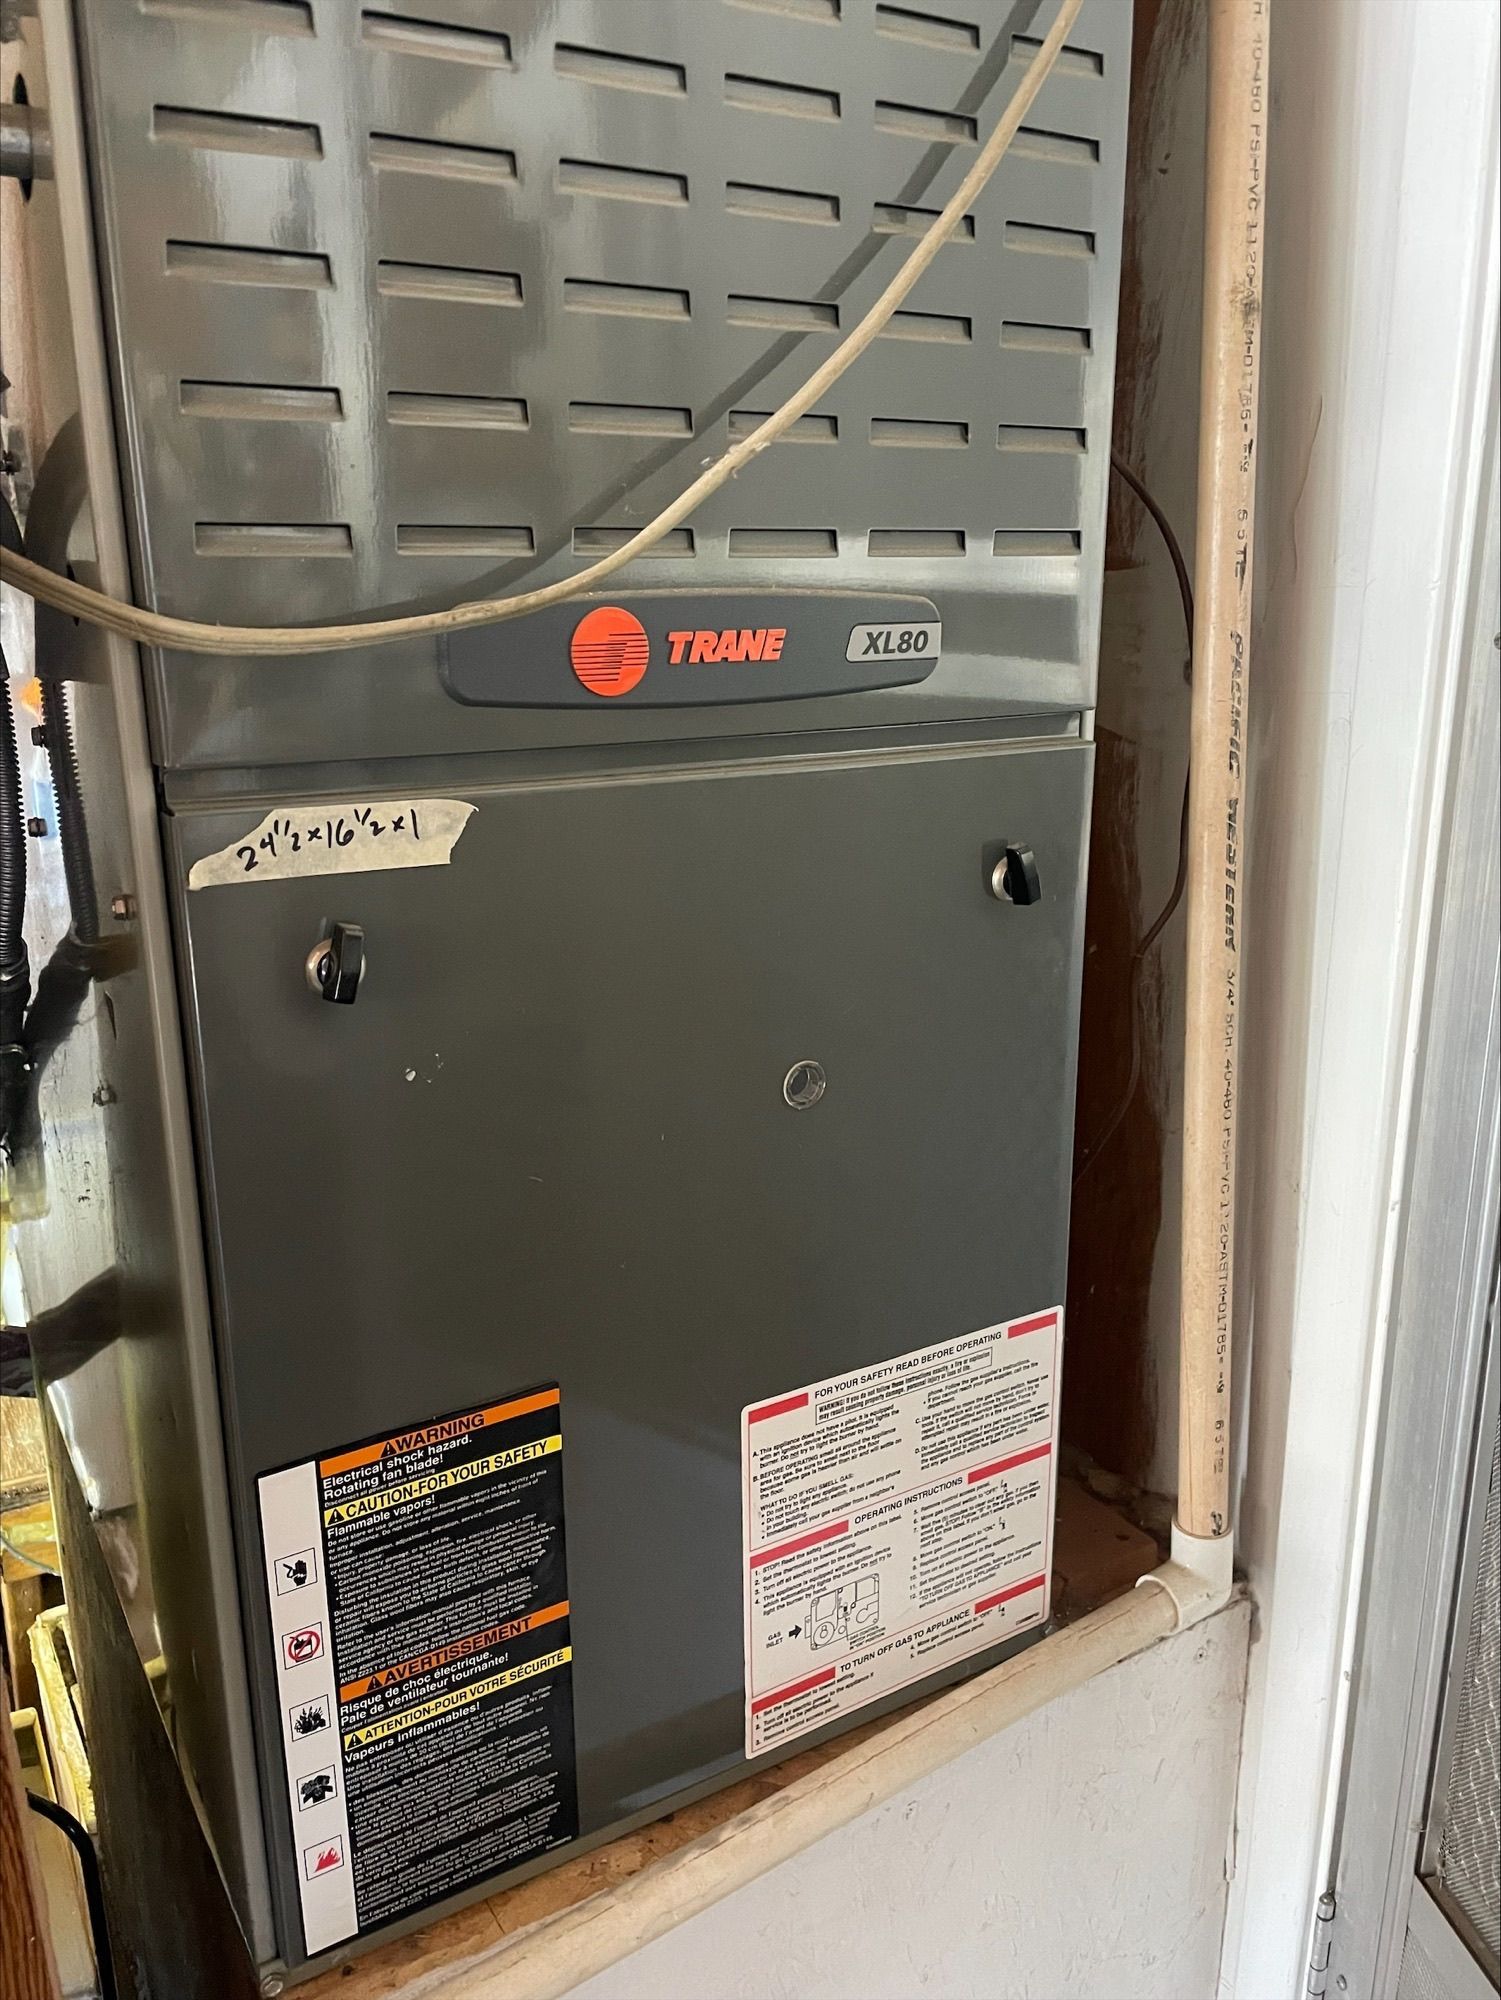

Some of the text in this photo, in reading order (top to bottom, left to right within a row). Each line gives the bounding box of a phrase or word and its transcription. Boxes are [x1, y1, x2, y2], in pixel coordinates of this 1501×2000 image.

[667, 627, 787, 665] TRANE
[861, 629, 930, 657] XL80
[1225, 797, 1238, 952] WESTERN
[815, 1331, 1002, 1399] FOR YOUR SAFETY READ BEFORE OPERATING
[322, 1432, 473, 1490] Electrical shock hazard.
[395, 1412, 485, 1453] WARNING
[324, 1453, 444, 1504] Rotating fan blade!
[345, 1440, 548, 1519] CAUTION-FOR YOUR SAFETY
[760, 1500, 778, 1512] WHAT
[779, 1496, 788, 1505] TO
[788, 1492, 798, 1501] DO
[799, 1490, 804, 1498] IF
[805, 1485, 818, 1495] YOU
[819, 1478, 838, 1490] SMELL
[855, 1476, 963, 1525] OPERATING INSTRUCTIONS
[327, 1494, 436, 1540] Flammable vapors!
[383, 1617, 532, 1685] AVERTISSEMENT
[766, 1637, 783, 1650] INLET
[768, 1631, 782, 1642] GAS
[840, 1661, 852, 1673] TO
[852, 1650, 876, 1668] TURN
[877, 1642, 894, 1657] OFF
[895, 1634, 913, 1649] GAS
[913, 1629, 925, 1641] TO
[926, 1608, 970, 1635] APPLIANCE
[340, 1648, 493, 1719] Risque de choc électrique.
[340, 1652, 509, 1727] Pale de ventilateur tournante!
[364, 1649, 564, 1741] ATTENTION-POUR VOTRE SÉCURITÉ
[344, 1701, 480, 1767] Vapeurs inflammables!
